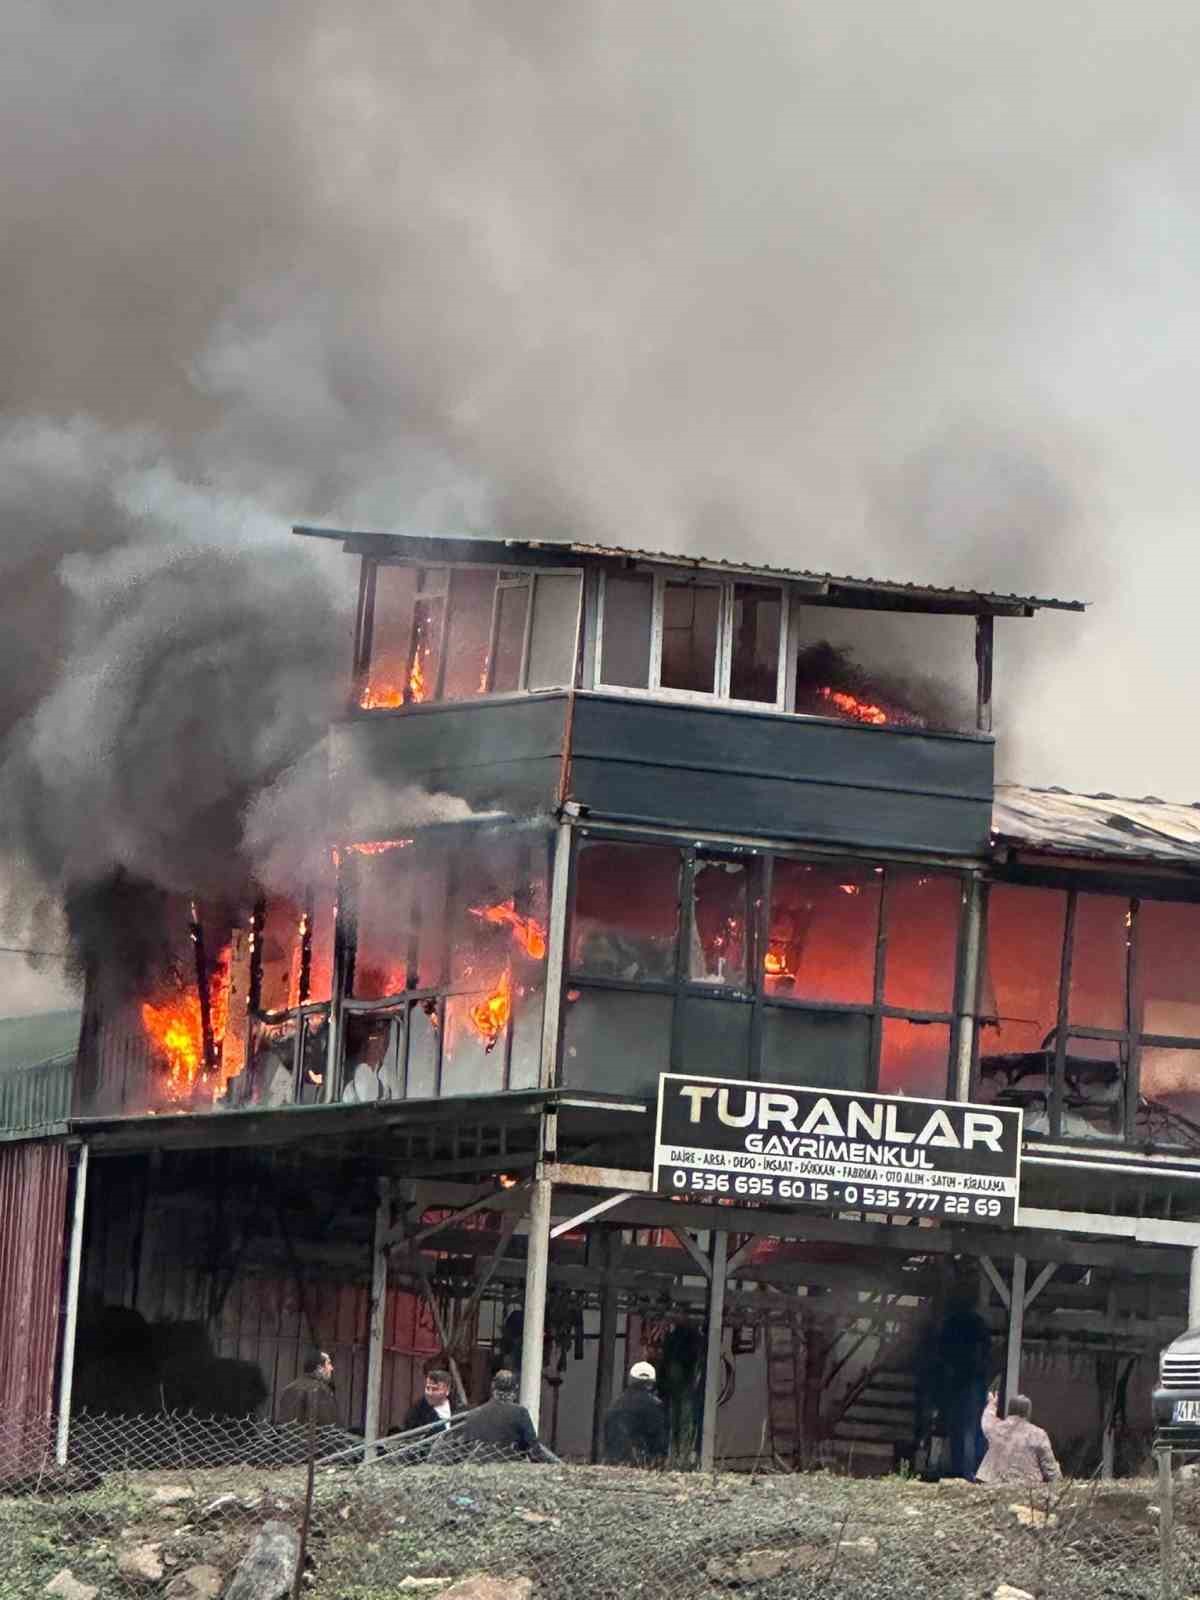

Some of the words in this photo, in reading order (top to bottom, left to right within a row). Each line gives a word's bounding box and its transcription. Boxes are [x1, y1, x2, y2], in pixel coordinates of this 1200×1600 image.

[680, 1086, 1003, 1152] TURANLAR
[703, 1153, 726, 1166] ARSA
[733, 1156, 756, 1169] DEPO
[885, 1171, 902, 1183] OTO
[904, 1172, 924, 1185] ALIM
[745, 1133, 934, 1169] GAYRİMENKUL
[673, 1170, 686, 1188] 0
[691, 1172, 729, 1192] 536
[735, 1176, 773, 1195] 695
[779, 1180, 805, 1198] 60
[810, 1183, 828, 1201] 15
[845, 1186, 858, 1203] 0
[863, 1188, 900, 1207] 535
[905, 1192, 940, 1211] 777
[944, 1195, 970, 1214] 22
[974, 1198, 1001, 1216] 69
